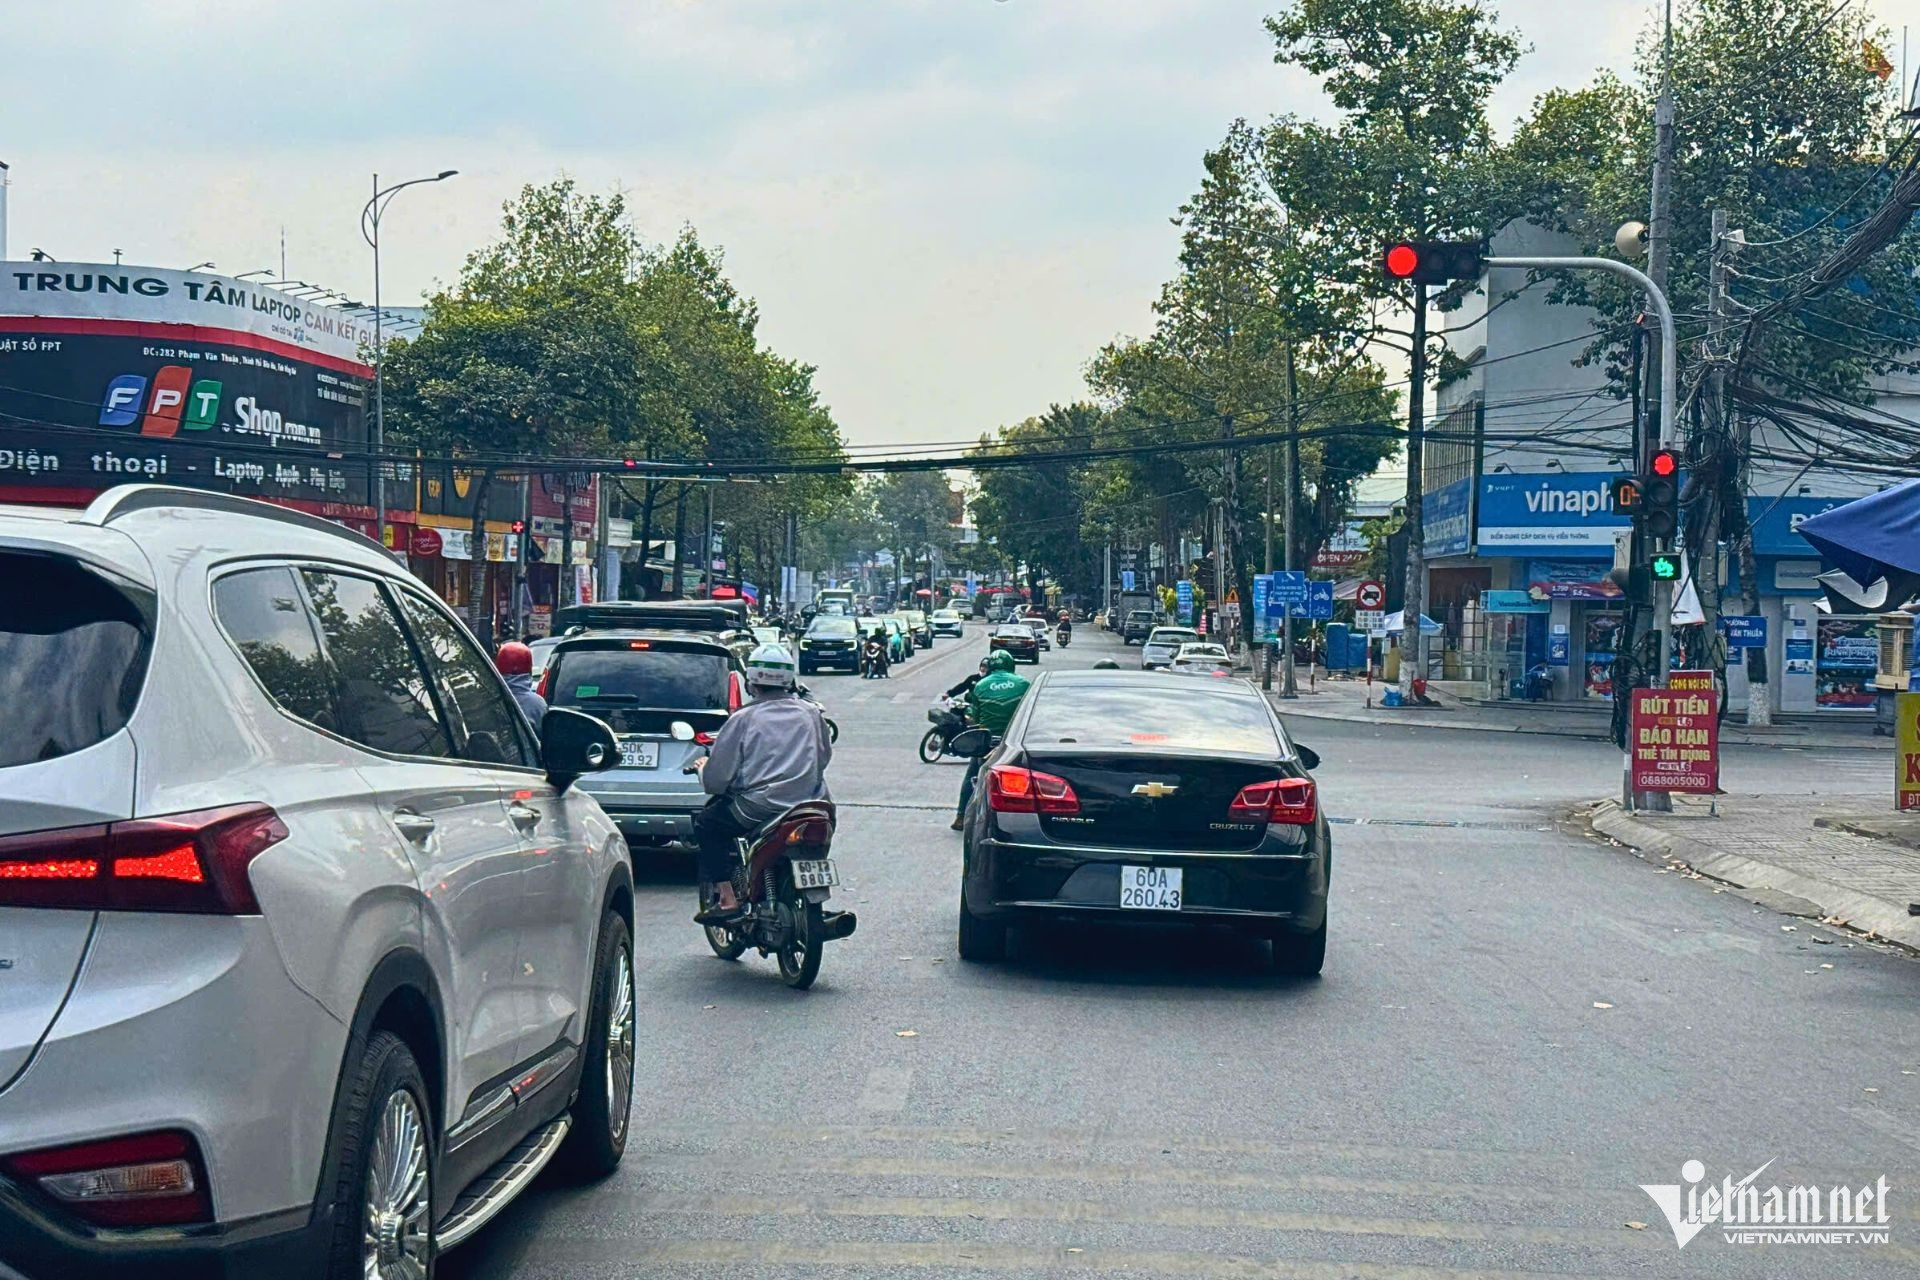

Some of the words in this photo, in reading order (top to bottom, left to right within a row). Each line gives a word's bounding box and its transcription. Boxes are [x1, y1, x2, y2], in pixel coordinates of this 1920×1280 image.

[12, 272, 169, 297] TRUNG
[184, 280, 246, 308] TÂM
[252, 293, 301, 323] LAPTOP
[304, 312, 334, 335] CAM
[337, 319, 356, 341] KẾT
[22, 337, 37, 351] SỐ
[42, 341, 62, 351] FPT
[178, 349, 201, 362] Phạm
[106, 387, 218, 418] FPT
[0, 449, 59, 476] Điện
[91, 451, 168, 479] thoại
[214, 456, 264, 485] Laptop
[1317, 554, 1340, 562] OPEN
[990, 680, 1015, 691] Grab
[1640, 695, 1671, 715] RÚT
[1674, 694, 1709, 716] TIỀN
[1640, 725, 1672, 745] BÁO
[1676, 728, 1709, 749] HẠN
[1638, 745, 1658, 760] THẺ
[1660, 746, 1678, 760] TÍN
[1135, 868, 1168, 889] 60A
[1122, 889, 1181, 909] 260.43
